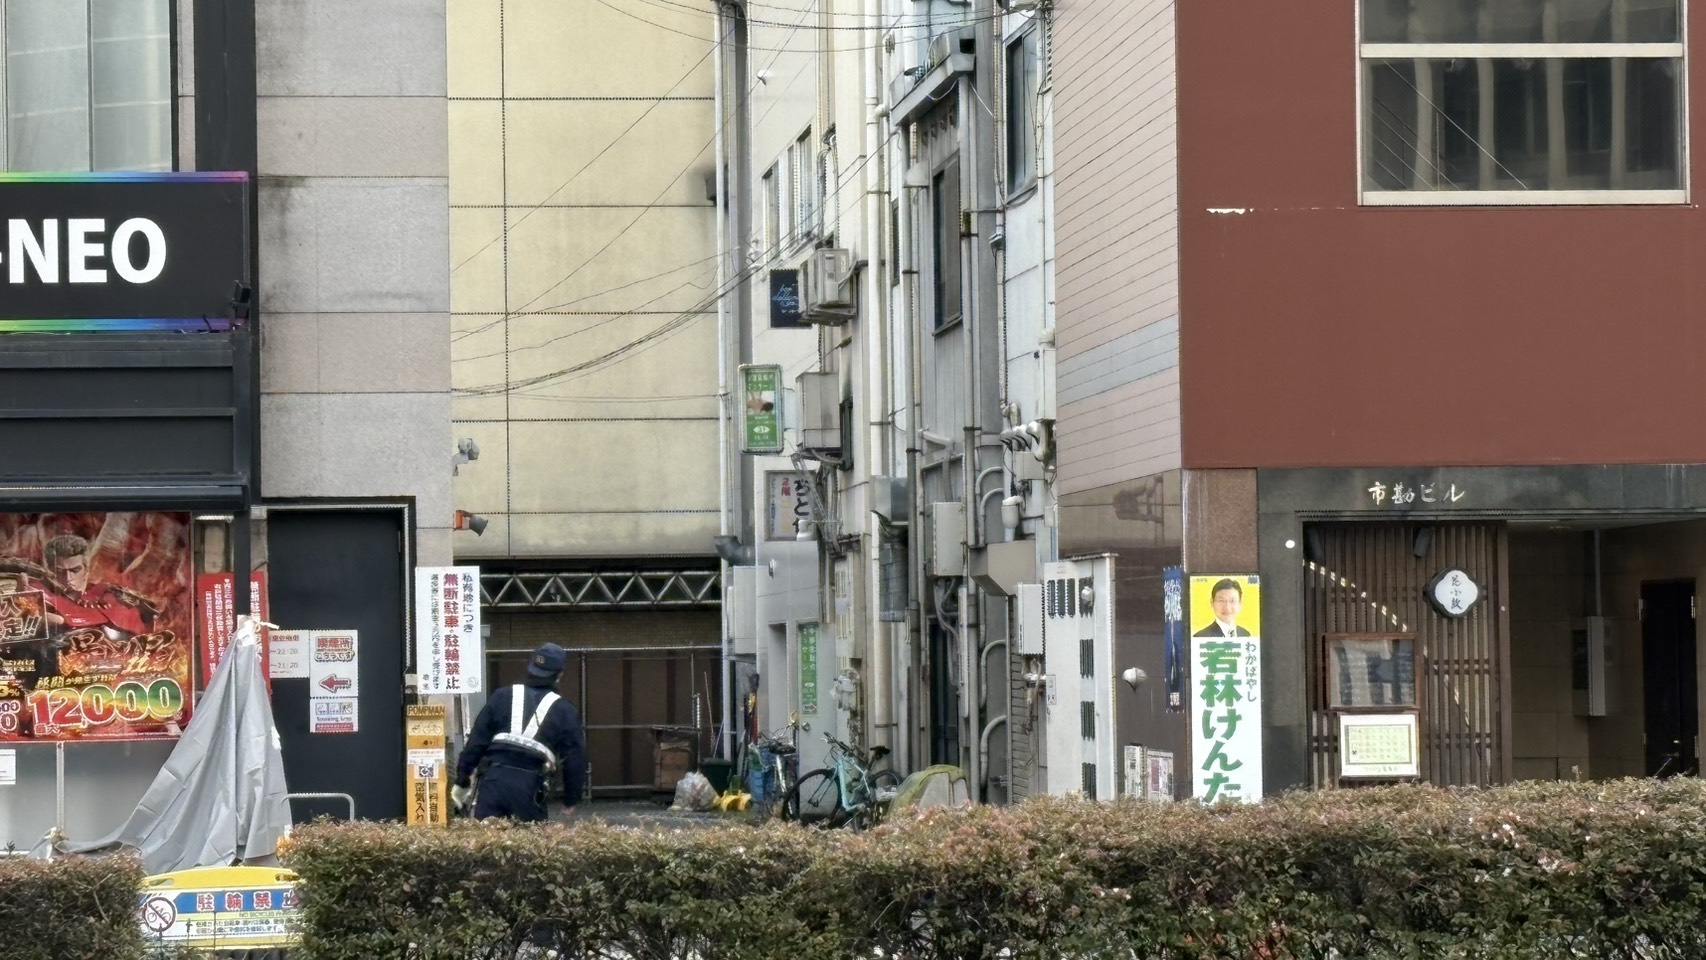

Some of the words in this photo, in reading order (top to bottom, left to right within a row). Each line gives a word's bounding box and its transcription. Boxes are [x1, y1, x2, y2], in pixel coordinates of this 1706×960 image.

[0, 217, 167, 284] NEO
[1367, 481, 1466, 507] 市勘ビル
[1245, 641, 1258, 702] わかばやし
[407, 704, 445, 716] POMPMAN
[1199, 641, 1243, 804] 若林けんた
